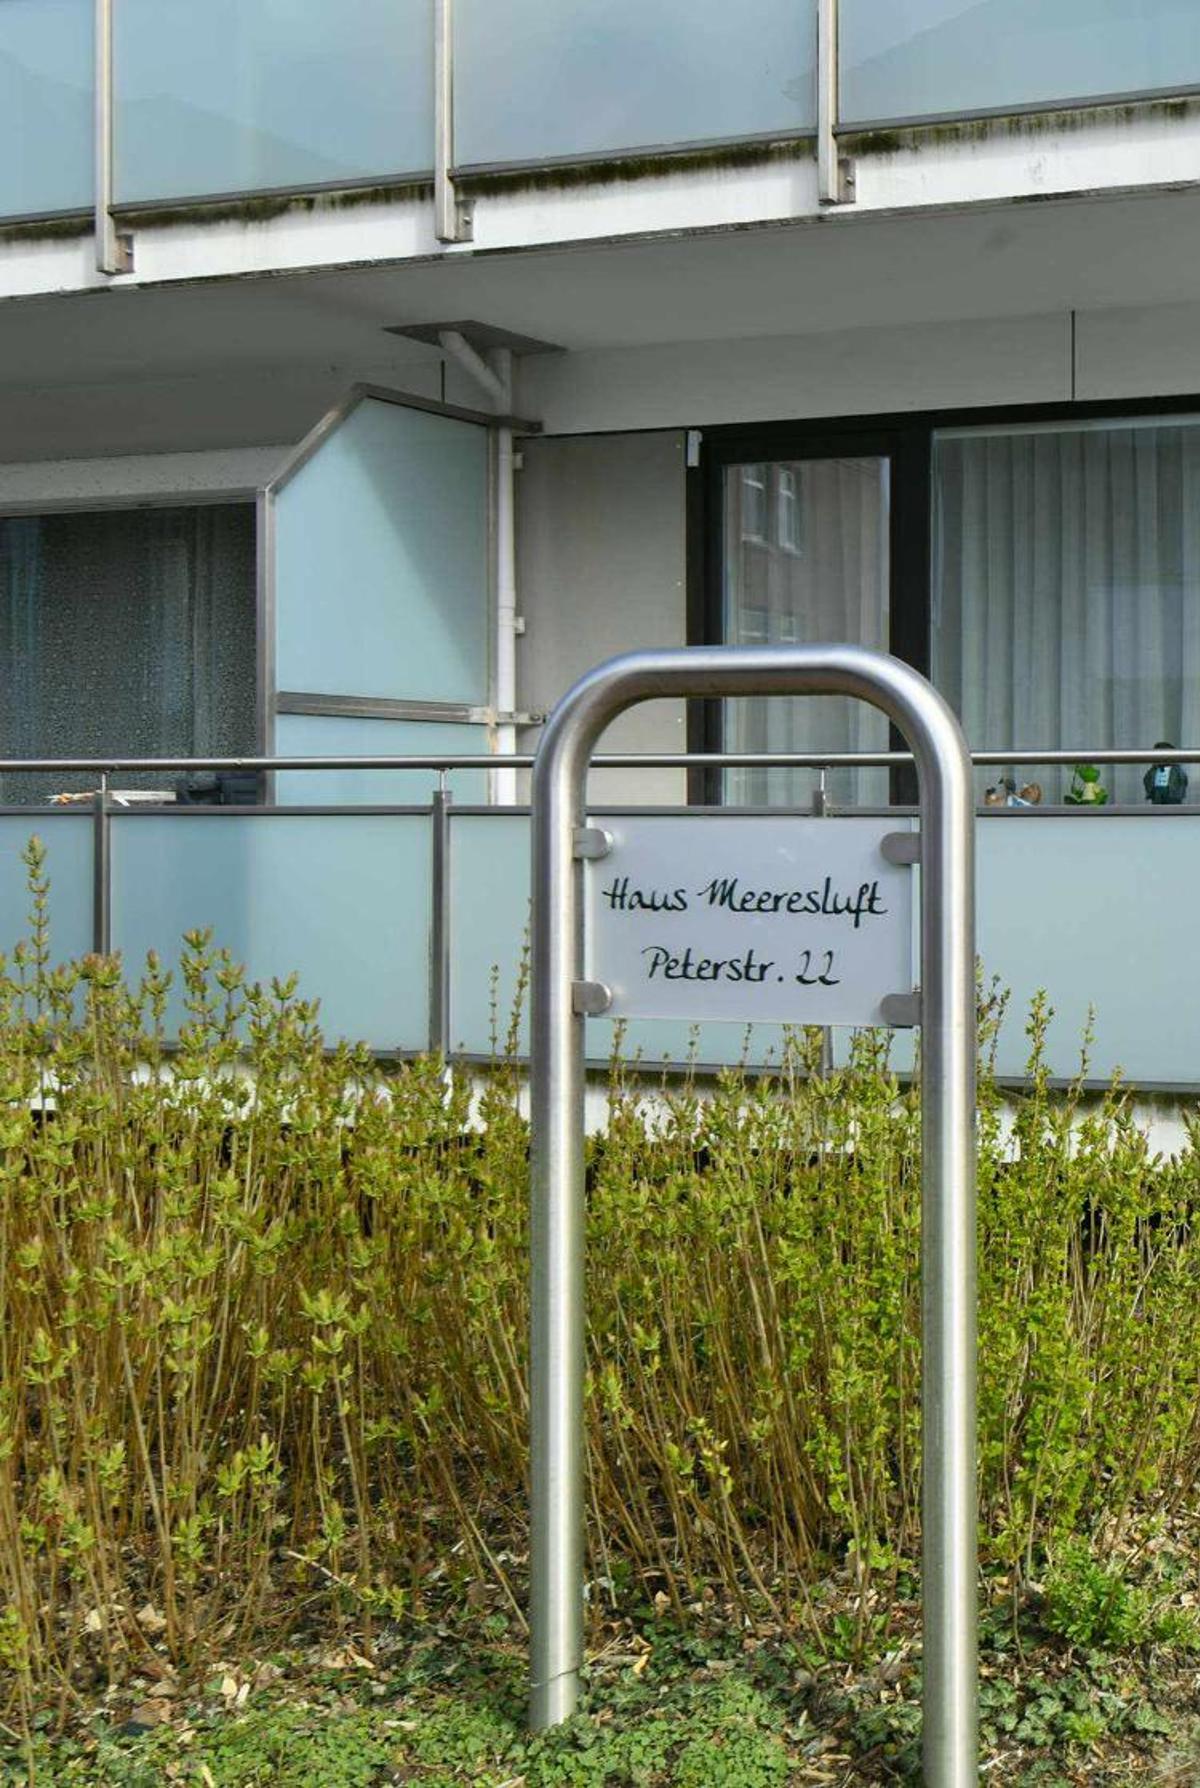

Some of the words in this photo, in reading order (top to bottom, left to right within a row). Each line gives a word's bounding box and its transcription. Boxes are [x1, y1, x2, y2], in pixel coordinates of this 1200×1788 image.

[602, 877, 688, 912] Haus
[696, 876, 888, 928] Meeresluft
[642, 945, 784, 982] Peterstr.
[796, 950, 840, 985] 22
